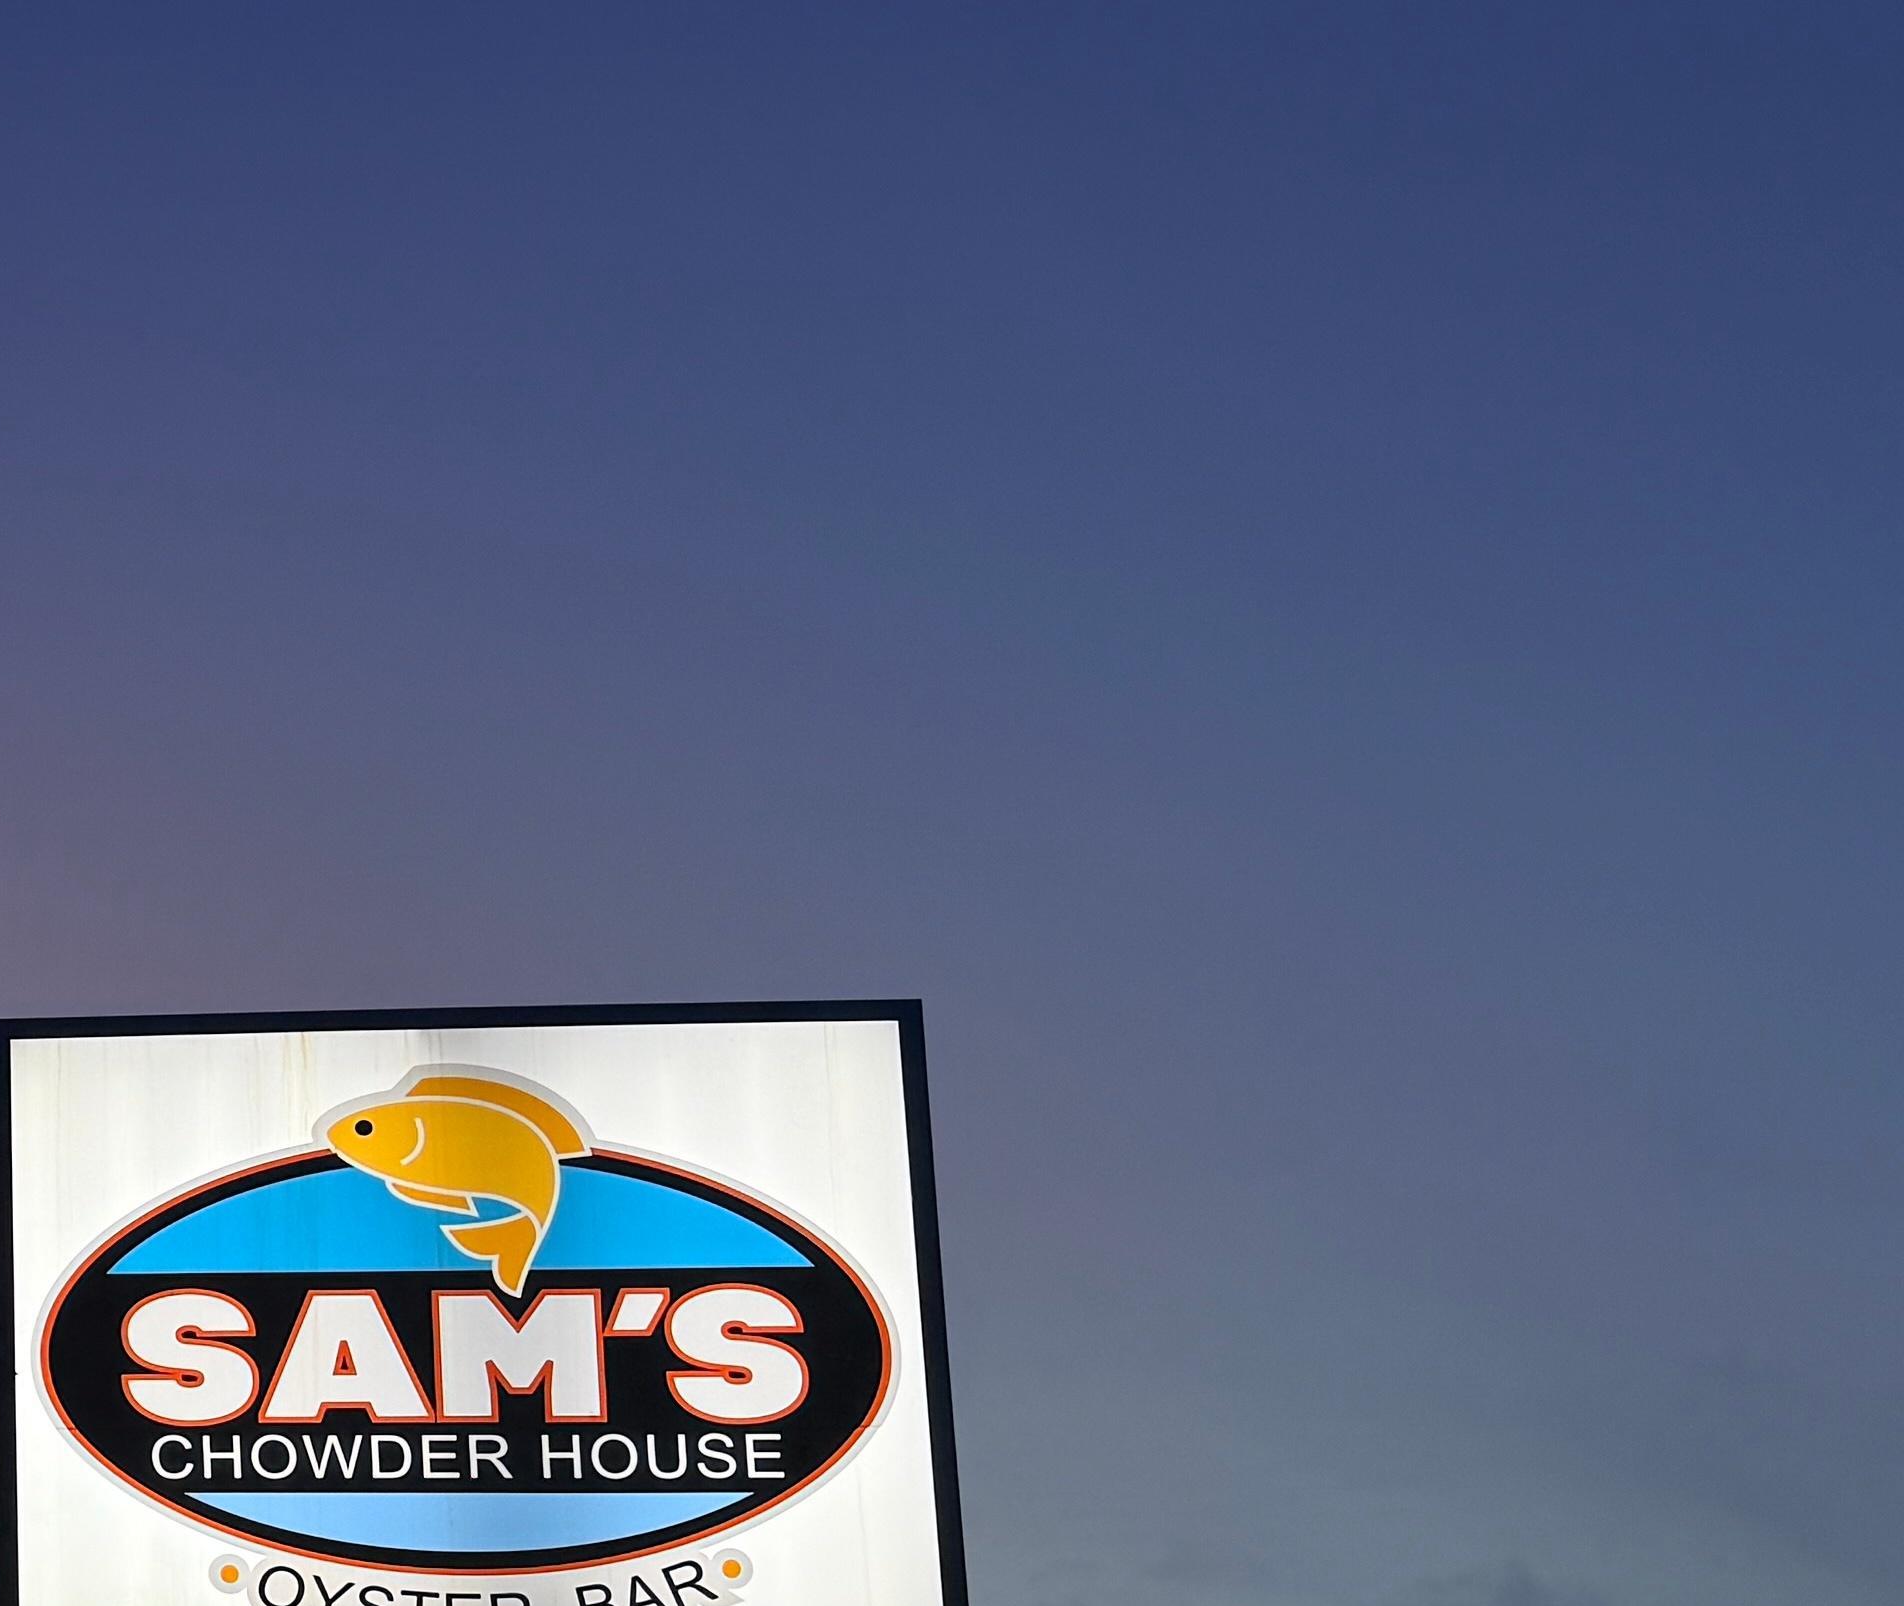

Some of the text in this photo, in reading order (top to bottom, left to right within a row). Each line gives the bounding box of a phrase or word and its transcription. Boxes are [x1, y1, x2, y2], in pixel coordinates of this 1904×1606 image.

[120, 1283, 809, 1427] SAM'S
[151, 1432, 787, 1480] CHOWDER HOUSE
